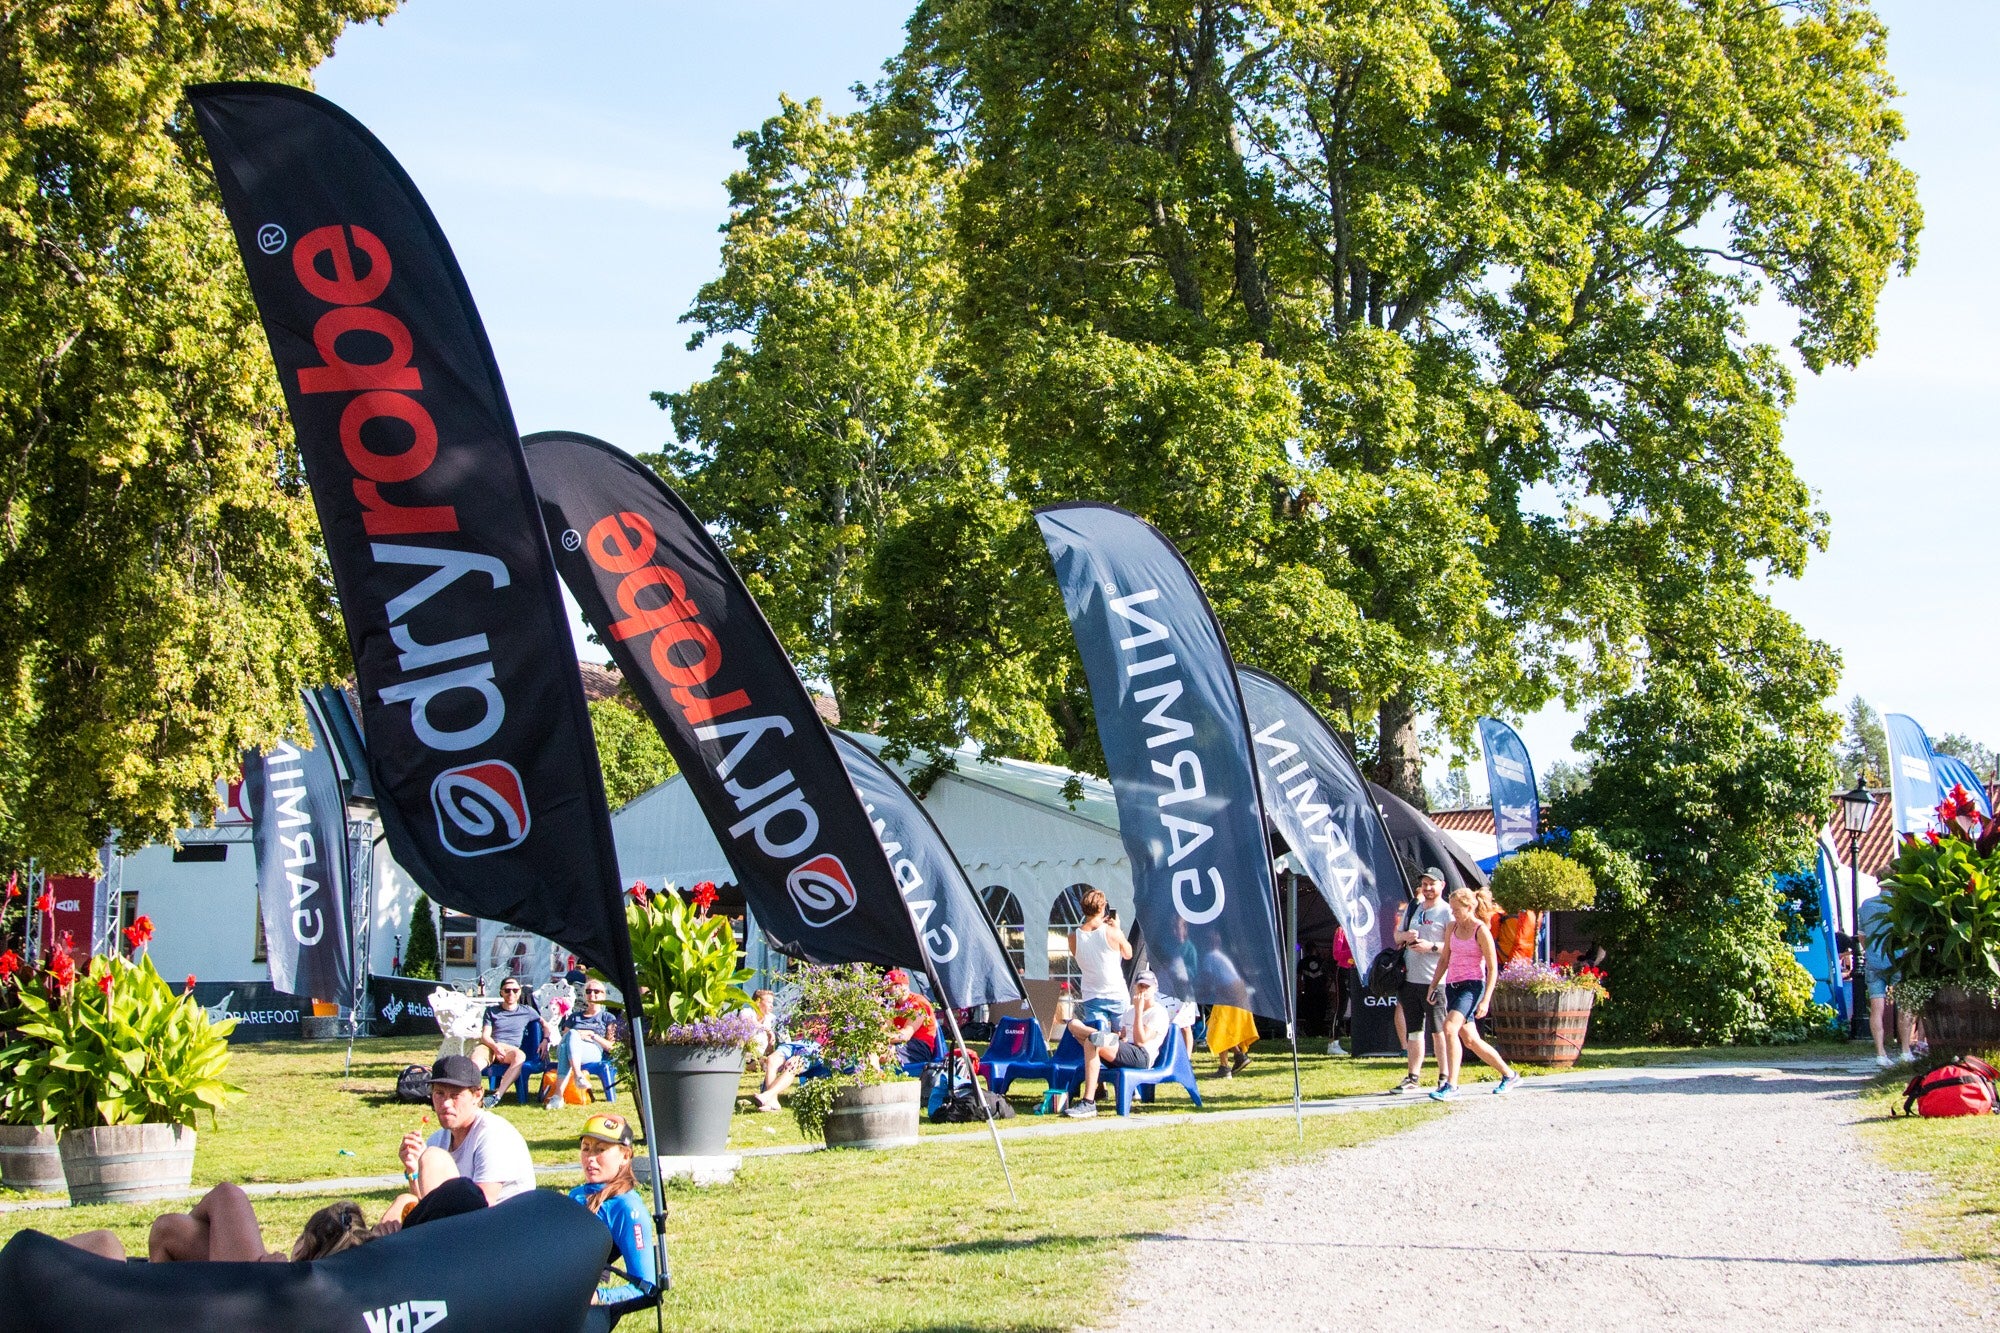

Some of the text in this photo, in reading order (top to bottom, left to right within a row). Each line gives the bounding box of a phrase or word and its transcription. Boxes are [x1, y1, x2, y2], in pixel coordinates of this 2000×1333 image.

[292, 224, 511, 751] dryrobe
[587, 512, 820, 858] dryrobe
[1364, 996, 1398, 1006] GAR
[224, 1010, 300, 1024] OBAREFOOT
[407, 1002, 434, 1017] #clea
